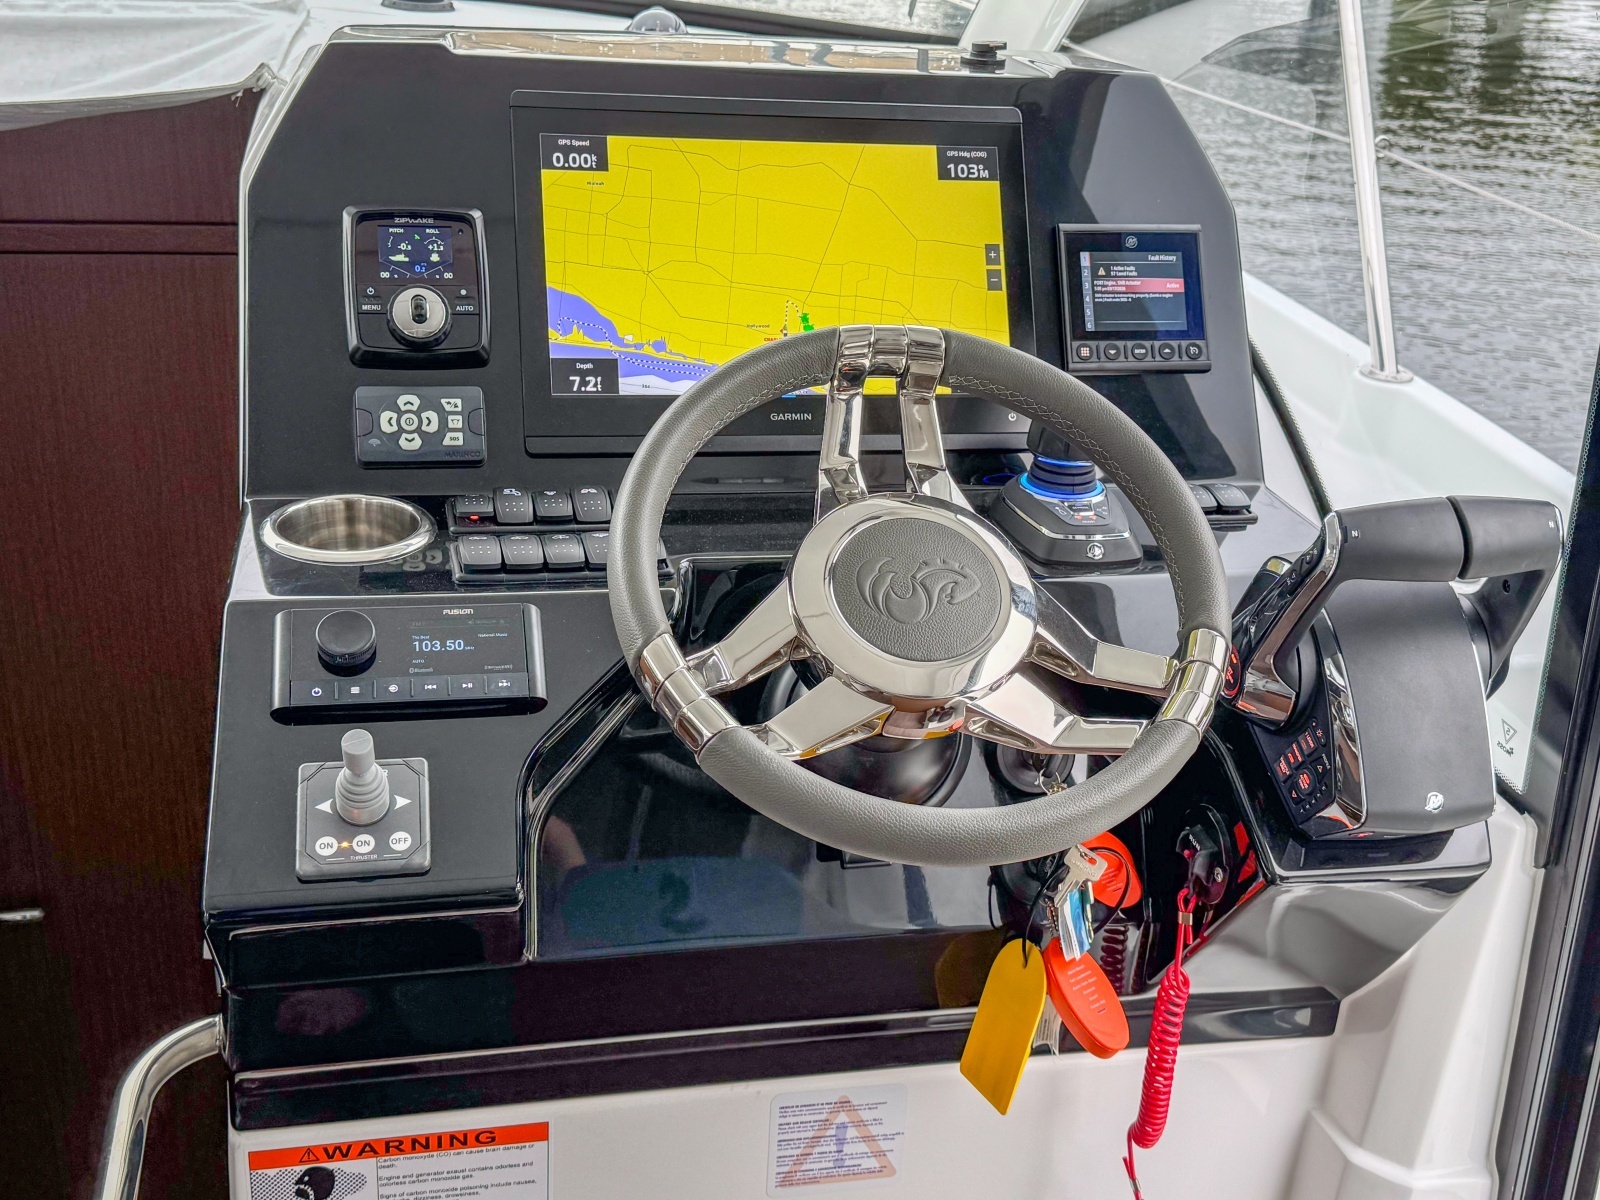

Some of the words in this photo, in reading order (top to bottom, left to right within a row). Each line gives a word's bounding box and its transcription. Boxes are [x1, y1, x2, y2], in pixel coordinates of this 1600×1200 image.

[552, 152, 591, 168] 0.00
[947, 163, 978, 178] 103
[569, 376, 597, 391] 7.2
[413, 640, 464, 652] 103.50
[356, 839, 371, 847] ON
[1189, 834, 1200, 851] RUN
[322, 1130, 497, 1160] WARNING
